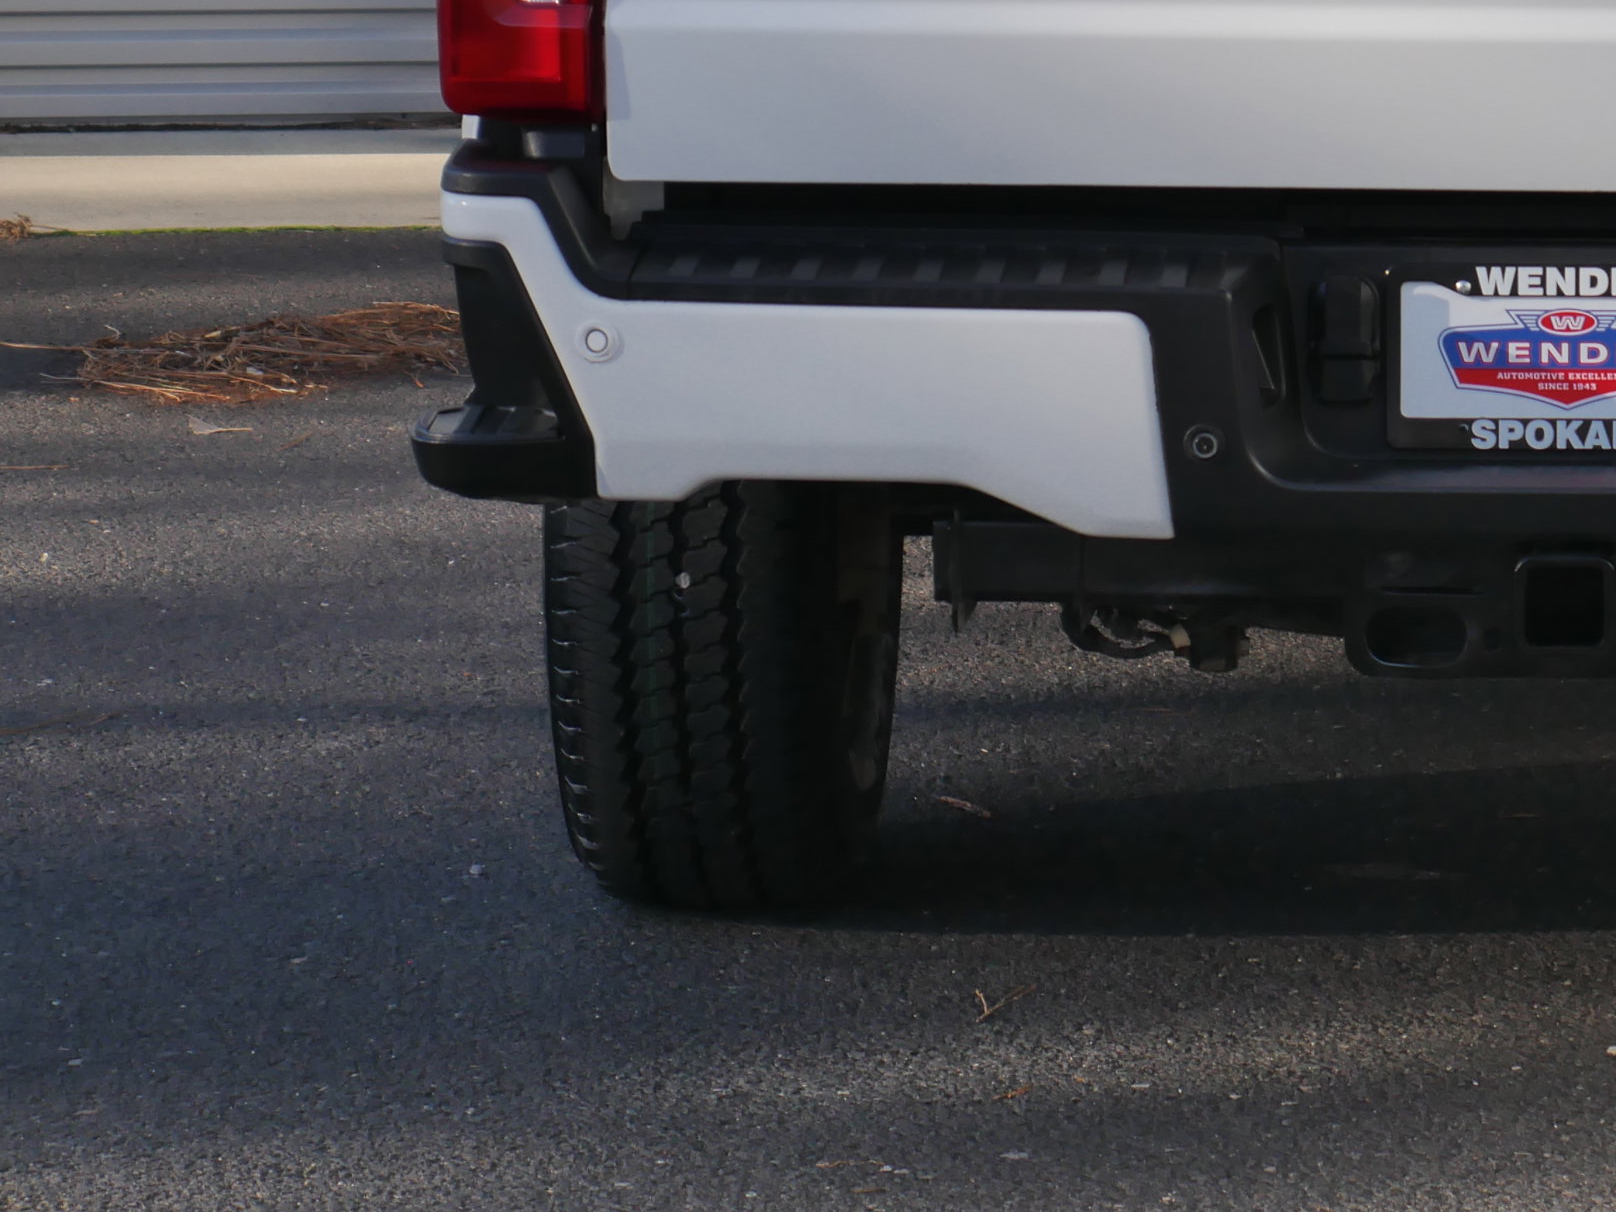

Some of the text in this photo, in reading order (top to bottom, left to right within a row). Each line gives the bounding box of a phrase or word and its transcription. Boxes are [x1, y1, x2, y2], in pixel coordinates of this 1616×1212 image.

[1550, 315, 1585, 331] W
[1496, 372, 1565, 381] AUTOMOTIVE
[1538, 382, 1597, 391] SINCE 1943
